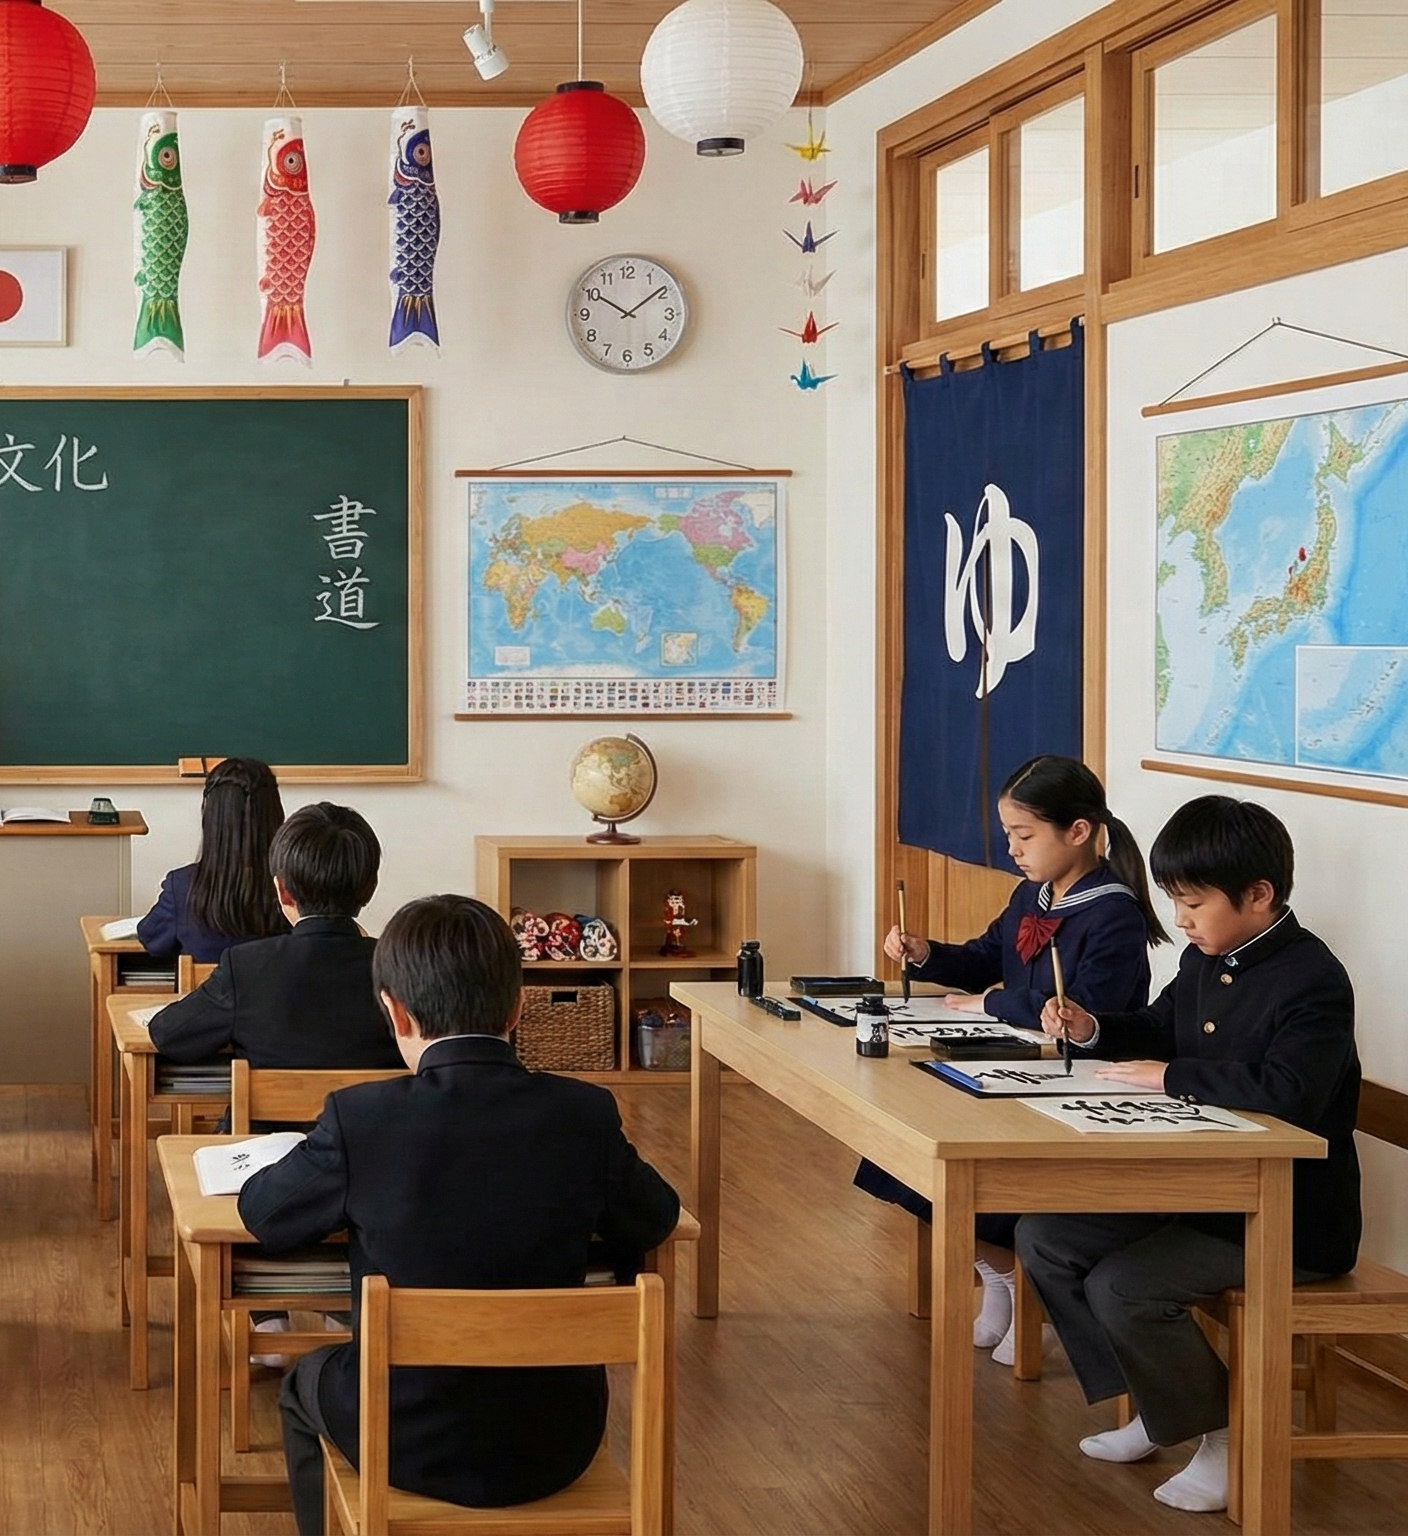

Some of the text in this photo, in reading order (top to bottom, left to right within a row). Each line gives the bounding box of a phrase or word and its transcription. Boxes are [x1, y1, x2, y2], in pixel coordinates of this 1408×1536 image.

[600, 272, 613, 286] 11
[619, 265, 635, 280] 12
[646, 272, 653, 286] 1
[585, 287, 601, 302] 10
[657, 285, 669, 300] 2
[579, 307, 590, 321] 9
[664, 307, 675, 321] 3
[586, 328, 597, 342] 8
[658, 328, 668, 341] 4
[603, 343, 612, 357] 7
[622, 349, 633, 363] 6
[643, 342, 654, 357] 5
[312, 494, 382, 630] 書道
[944, 483, 1039, 700] ゆ
